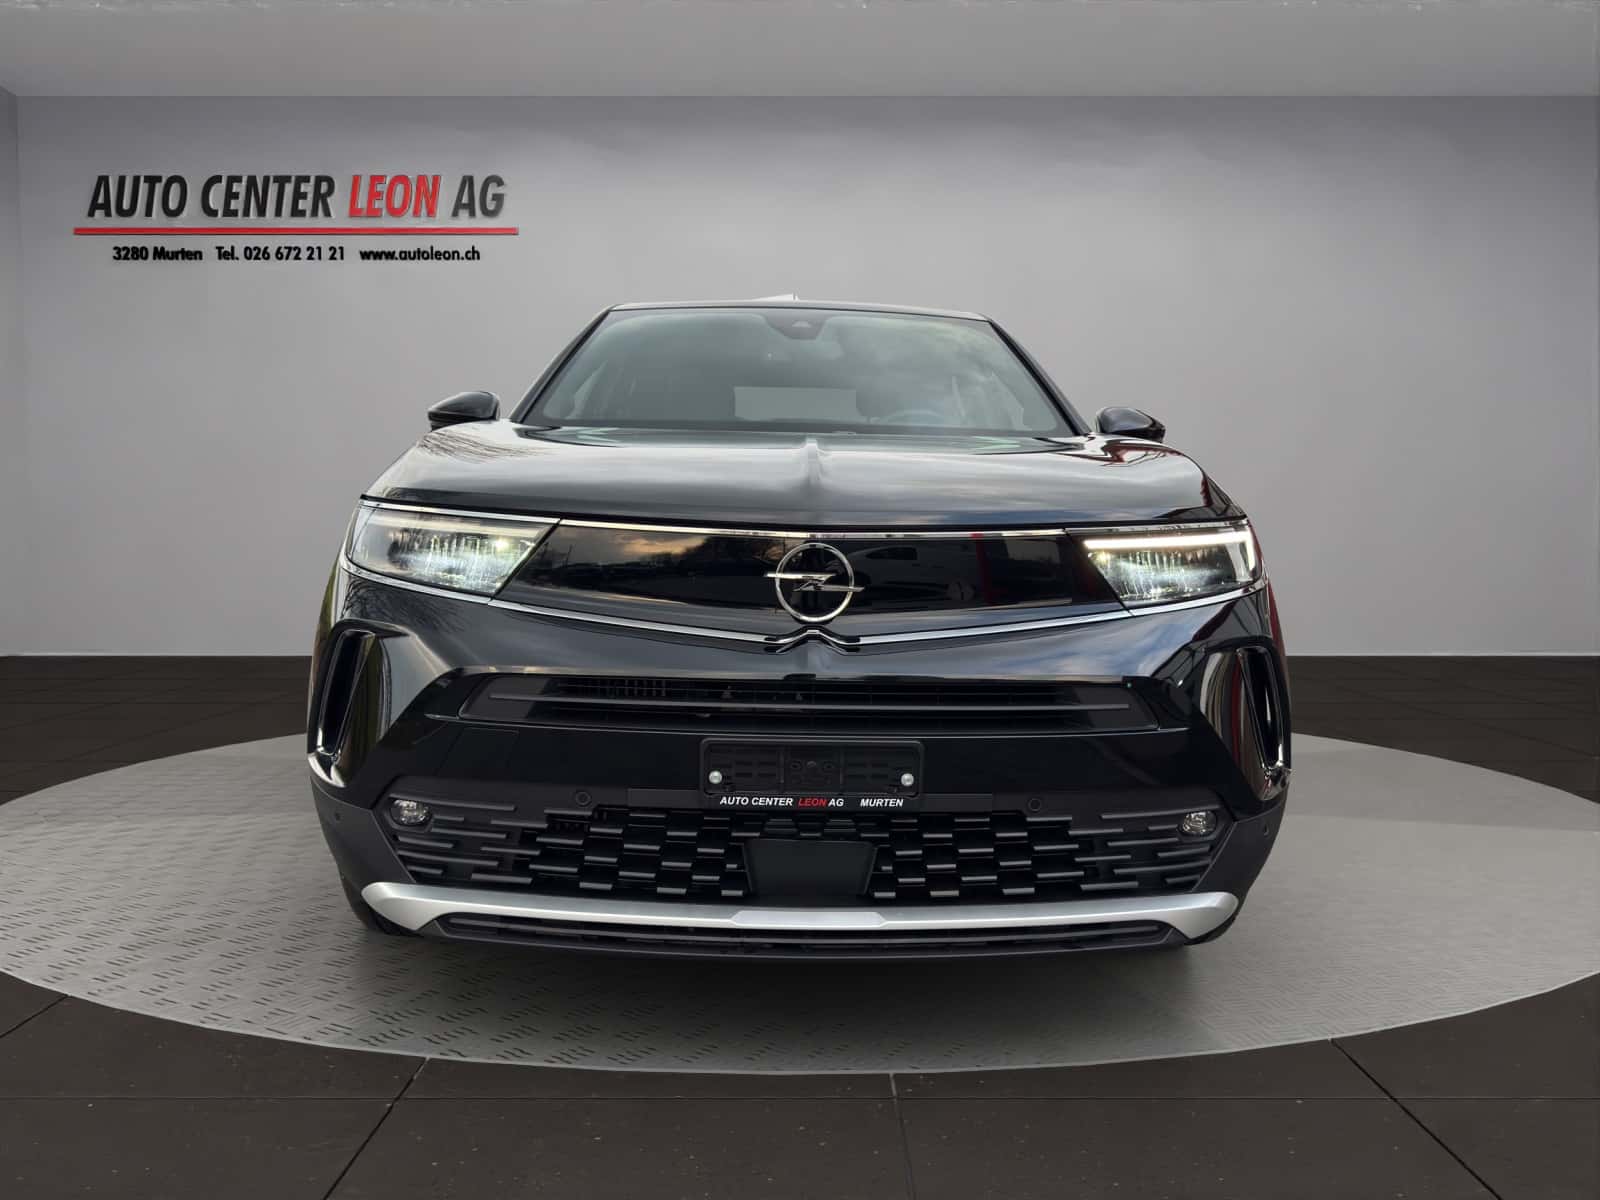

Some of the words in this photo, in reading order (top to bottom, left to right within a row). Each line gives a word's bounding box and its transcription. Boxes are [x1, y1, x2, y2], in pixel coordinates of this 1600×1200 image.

[87, 174, 188, 218] AUTO
[201, 174, 335, 218] CENTER
[348, 174, 441, 218] LEON
[451, 174, 506, 218] AG
[112, 246, 149, 261] 3280
[152, 246, 203, 261] Murten
[216, 246, 239, 261] Tel.
[243, 246, 272, 261] 026
[275, 246, 301, 261] 672
[304, 246, 322, 261] 21
[328, 246, 345, 261] 21
[359, 246, 481, 261] www.autoleon.ch
[720, 796, 749, 806] AUTO
[751, 796, 793, 806] CENTER
[798, 797, 826, 807] LEON
[828, 798, 844, 807] AG
[860, 798, 904, 808] MURTEN
